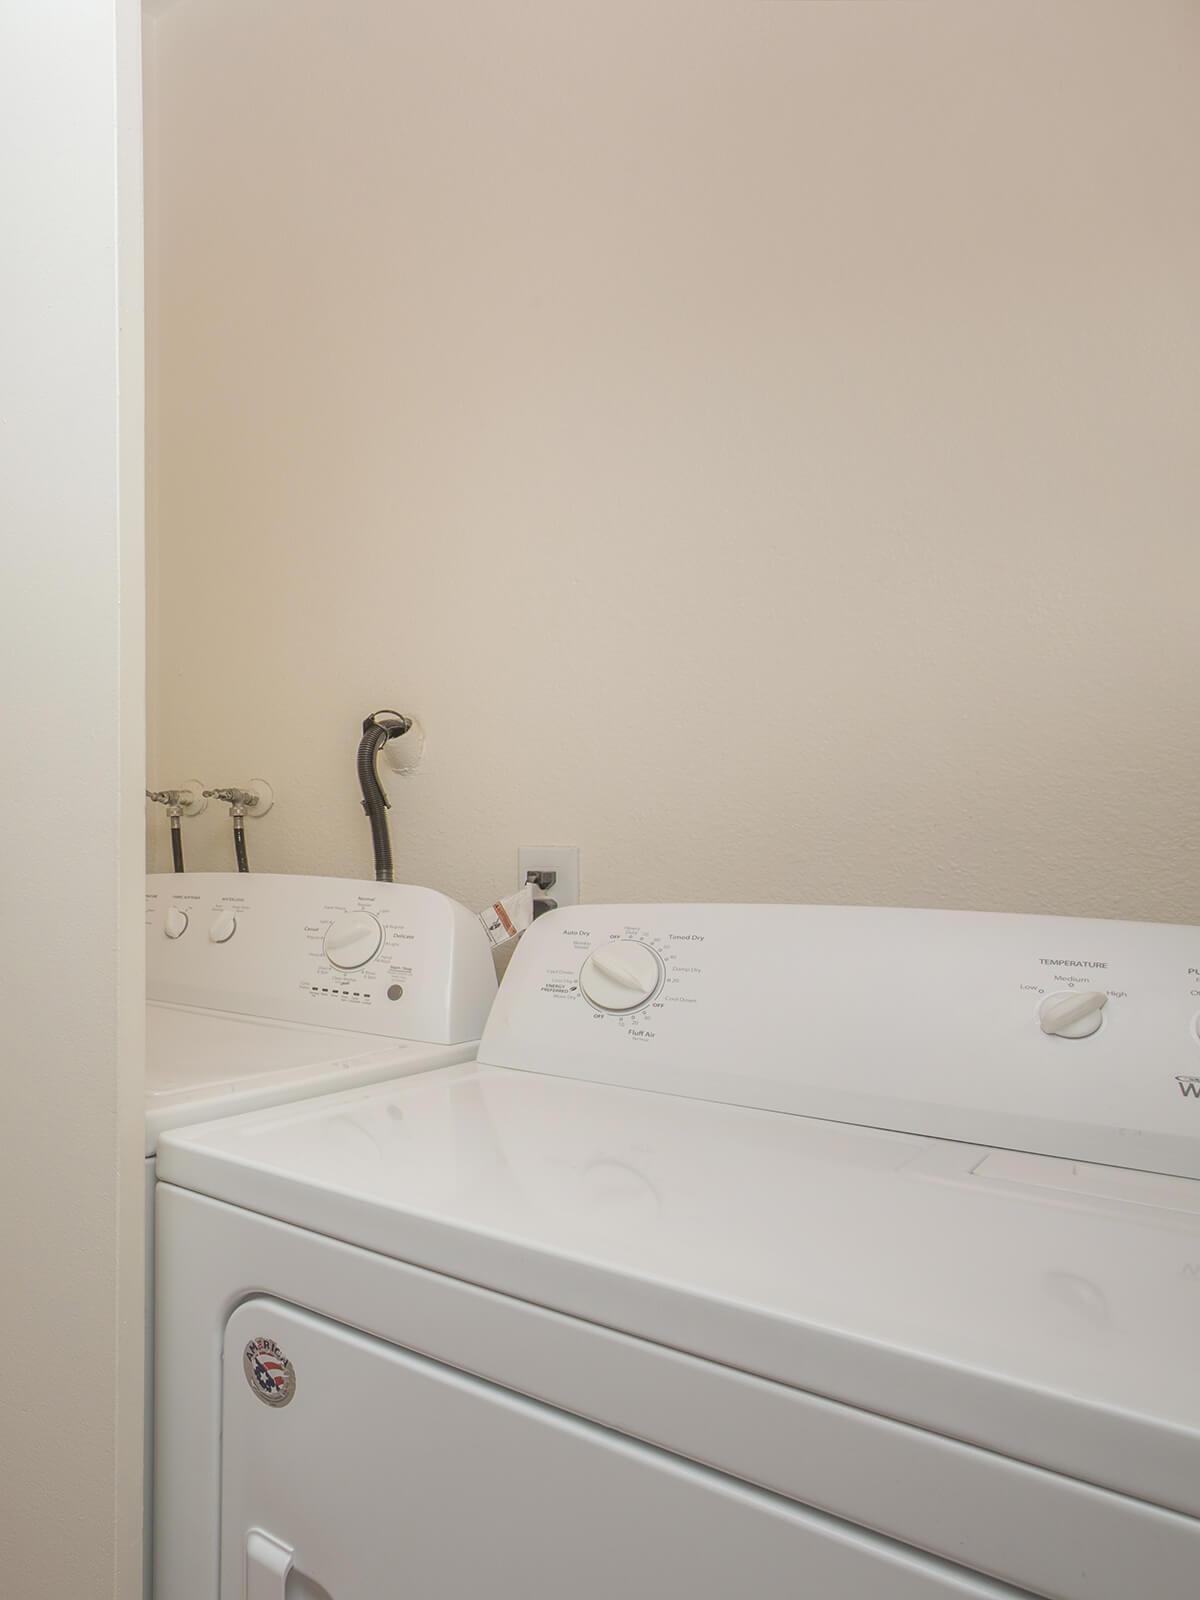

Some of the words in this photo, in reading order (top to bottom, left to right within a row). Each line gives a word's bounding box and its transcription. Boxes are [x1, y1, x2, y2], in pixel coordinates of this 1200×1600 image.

[1039, 958, 1108, 969] TEMPERATURE
[1054, 975, 1090, 983] Medium
[1106, 990, 1128, 998] High
[628, 1028, 644, 1037] Fluff
[644, 1030, 656, 1038] Air
